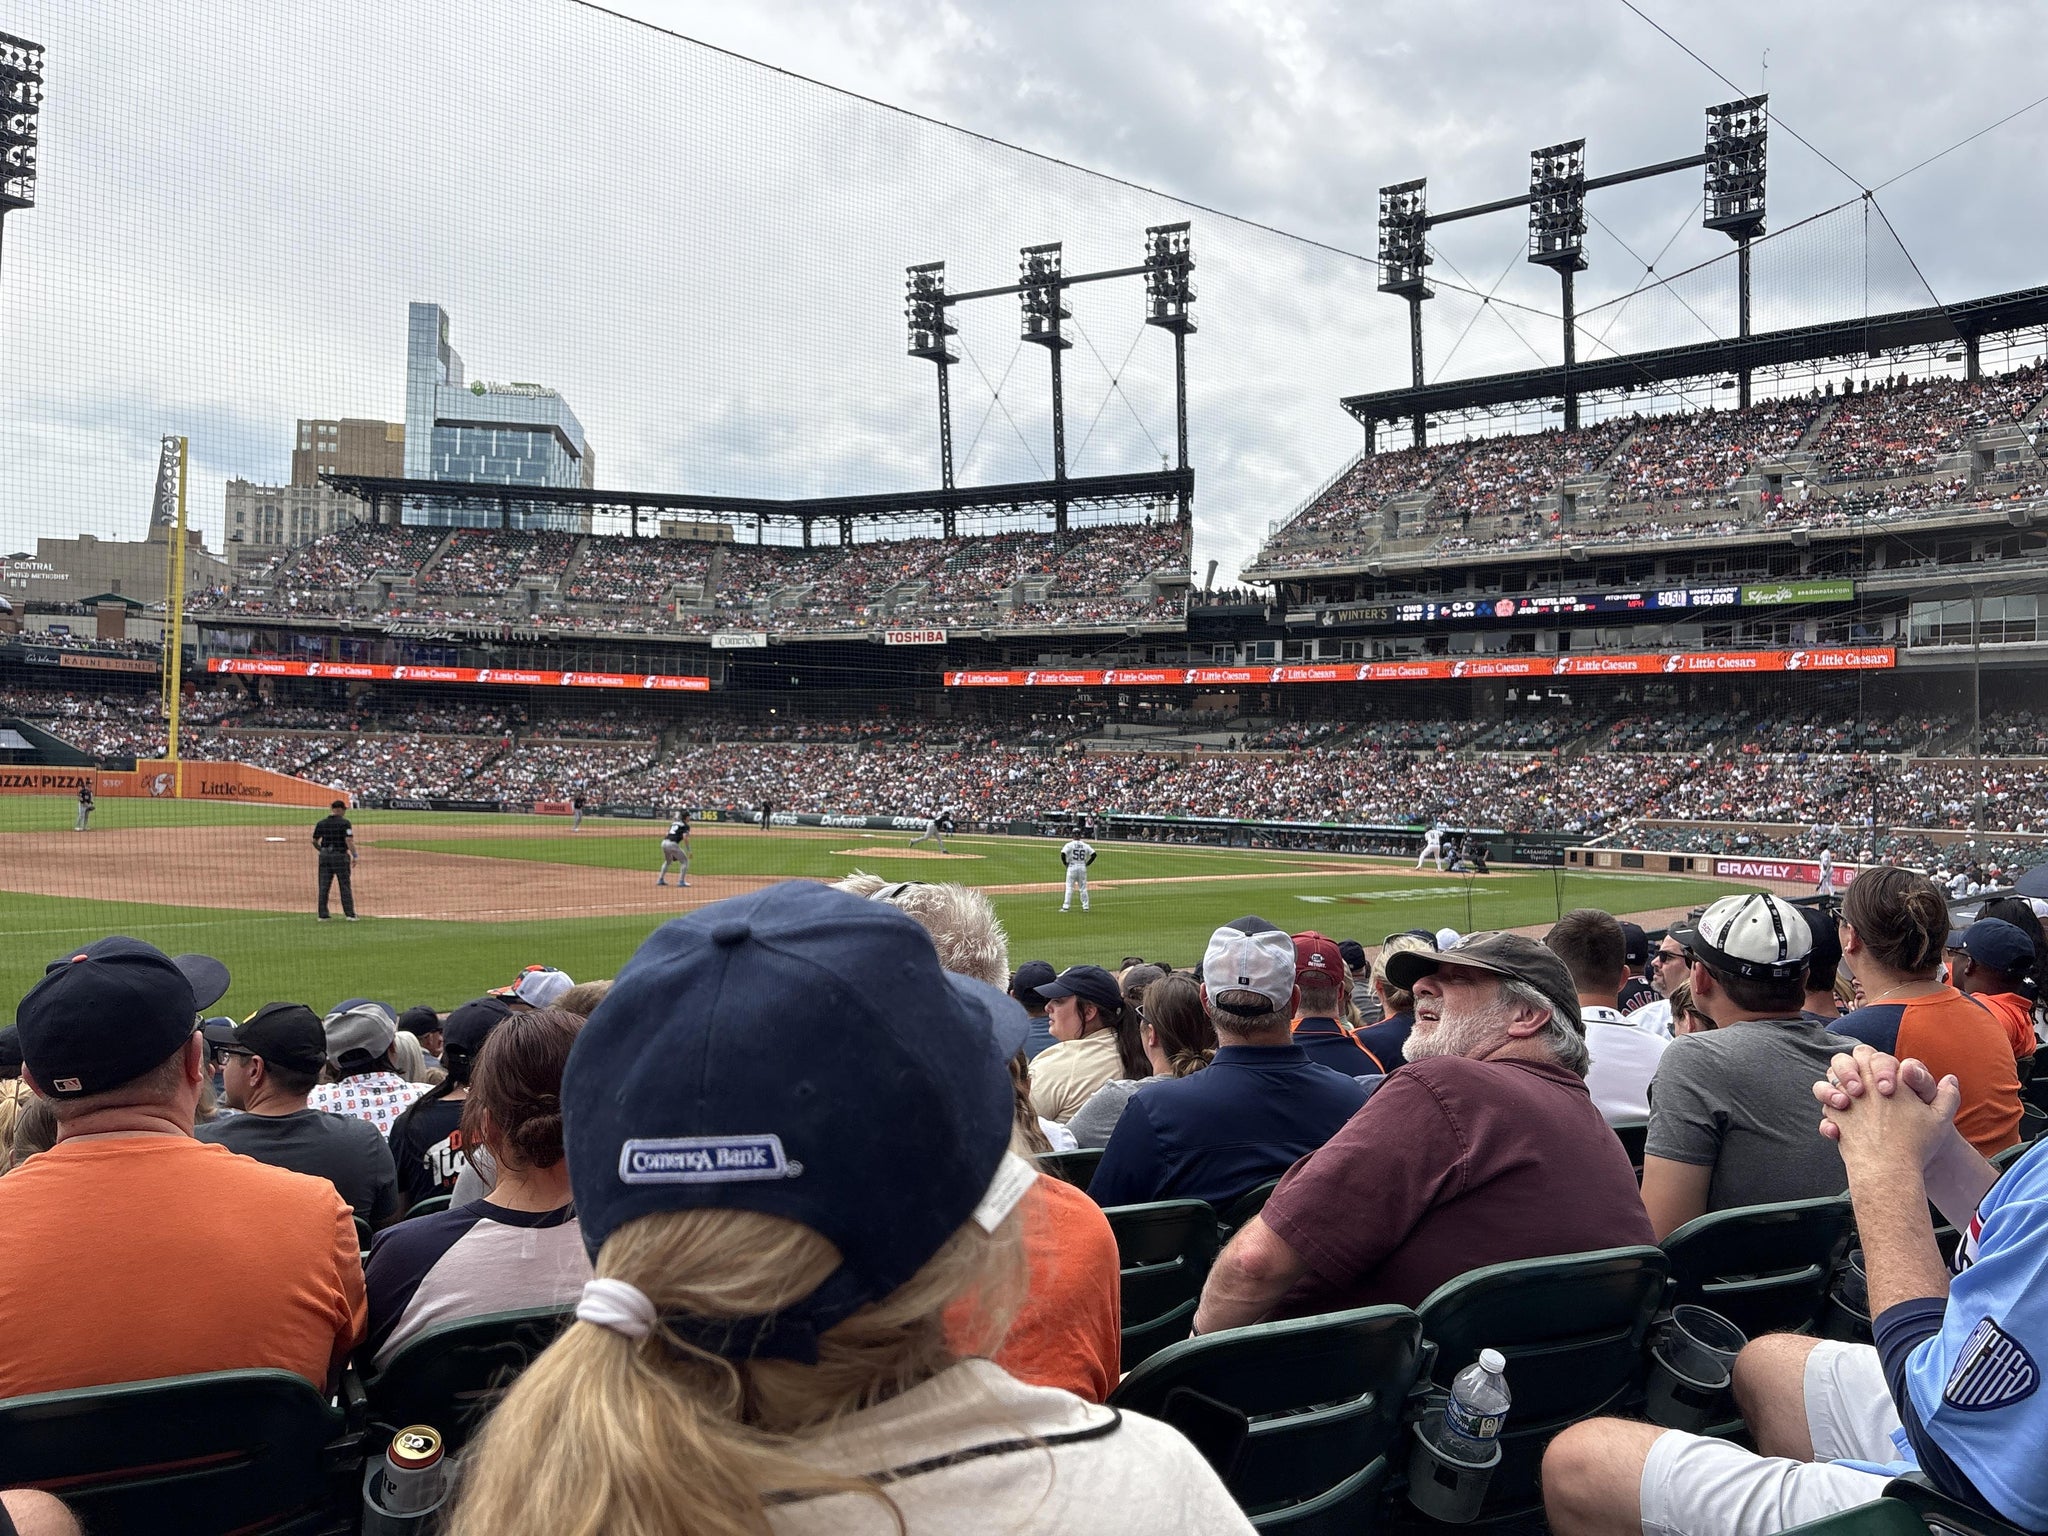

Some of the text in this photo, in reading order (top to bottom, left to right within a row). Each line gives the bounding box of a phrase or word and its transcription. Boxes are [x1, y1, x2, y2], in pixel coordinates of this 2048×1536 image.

[488, 381, 555, 400] Huntington
[14, 562, 54, 571] CENTRAL
[1531, 596, 1577, 606] VIERLING
[1337, 608, 1388, 622] WINTER'S
[1402, 612, 1422, 621] DET
[512, 631, 539, 642] CLUB
[888, 631, 944, 643] TOSHIBA
[1688, 657, 1756, 669] Little Caesars
[1813, 653, 1889, 666] Little Caesars
[237, 663, 285, 673] Little Caesars
[325, 665, 372, 676] Little Caesars
[1472, 663, 1529, 674] Little Caesars
[1576, 660, 1637, 671] Little Caesars
[410, 668, 457, 679] Little Caesars
[1119, 672, 1165, 681] Little Caesars
[1201, 671, 1250, 680] Little Caesars
[1288, 669, 1336, 678] Little Caesars
[1376, 667, 1429, 676] Little Caesars
[967, 674, 1008, 683] Little Caesars
[1041, 673, 1085, 683] Little Caesars
[200, 780, 236, 796] Little
[820, 814, 868, 827] Dunham's
[1073, 849, 1086, 861] 56
[1717, 862, 1790, 878] GRAVELY
[716, 1147, 768, 1168] Bank
